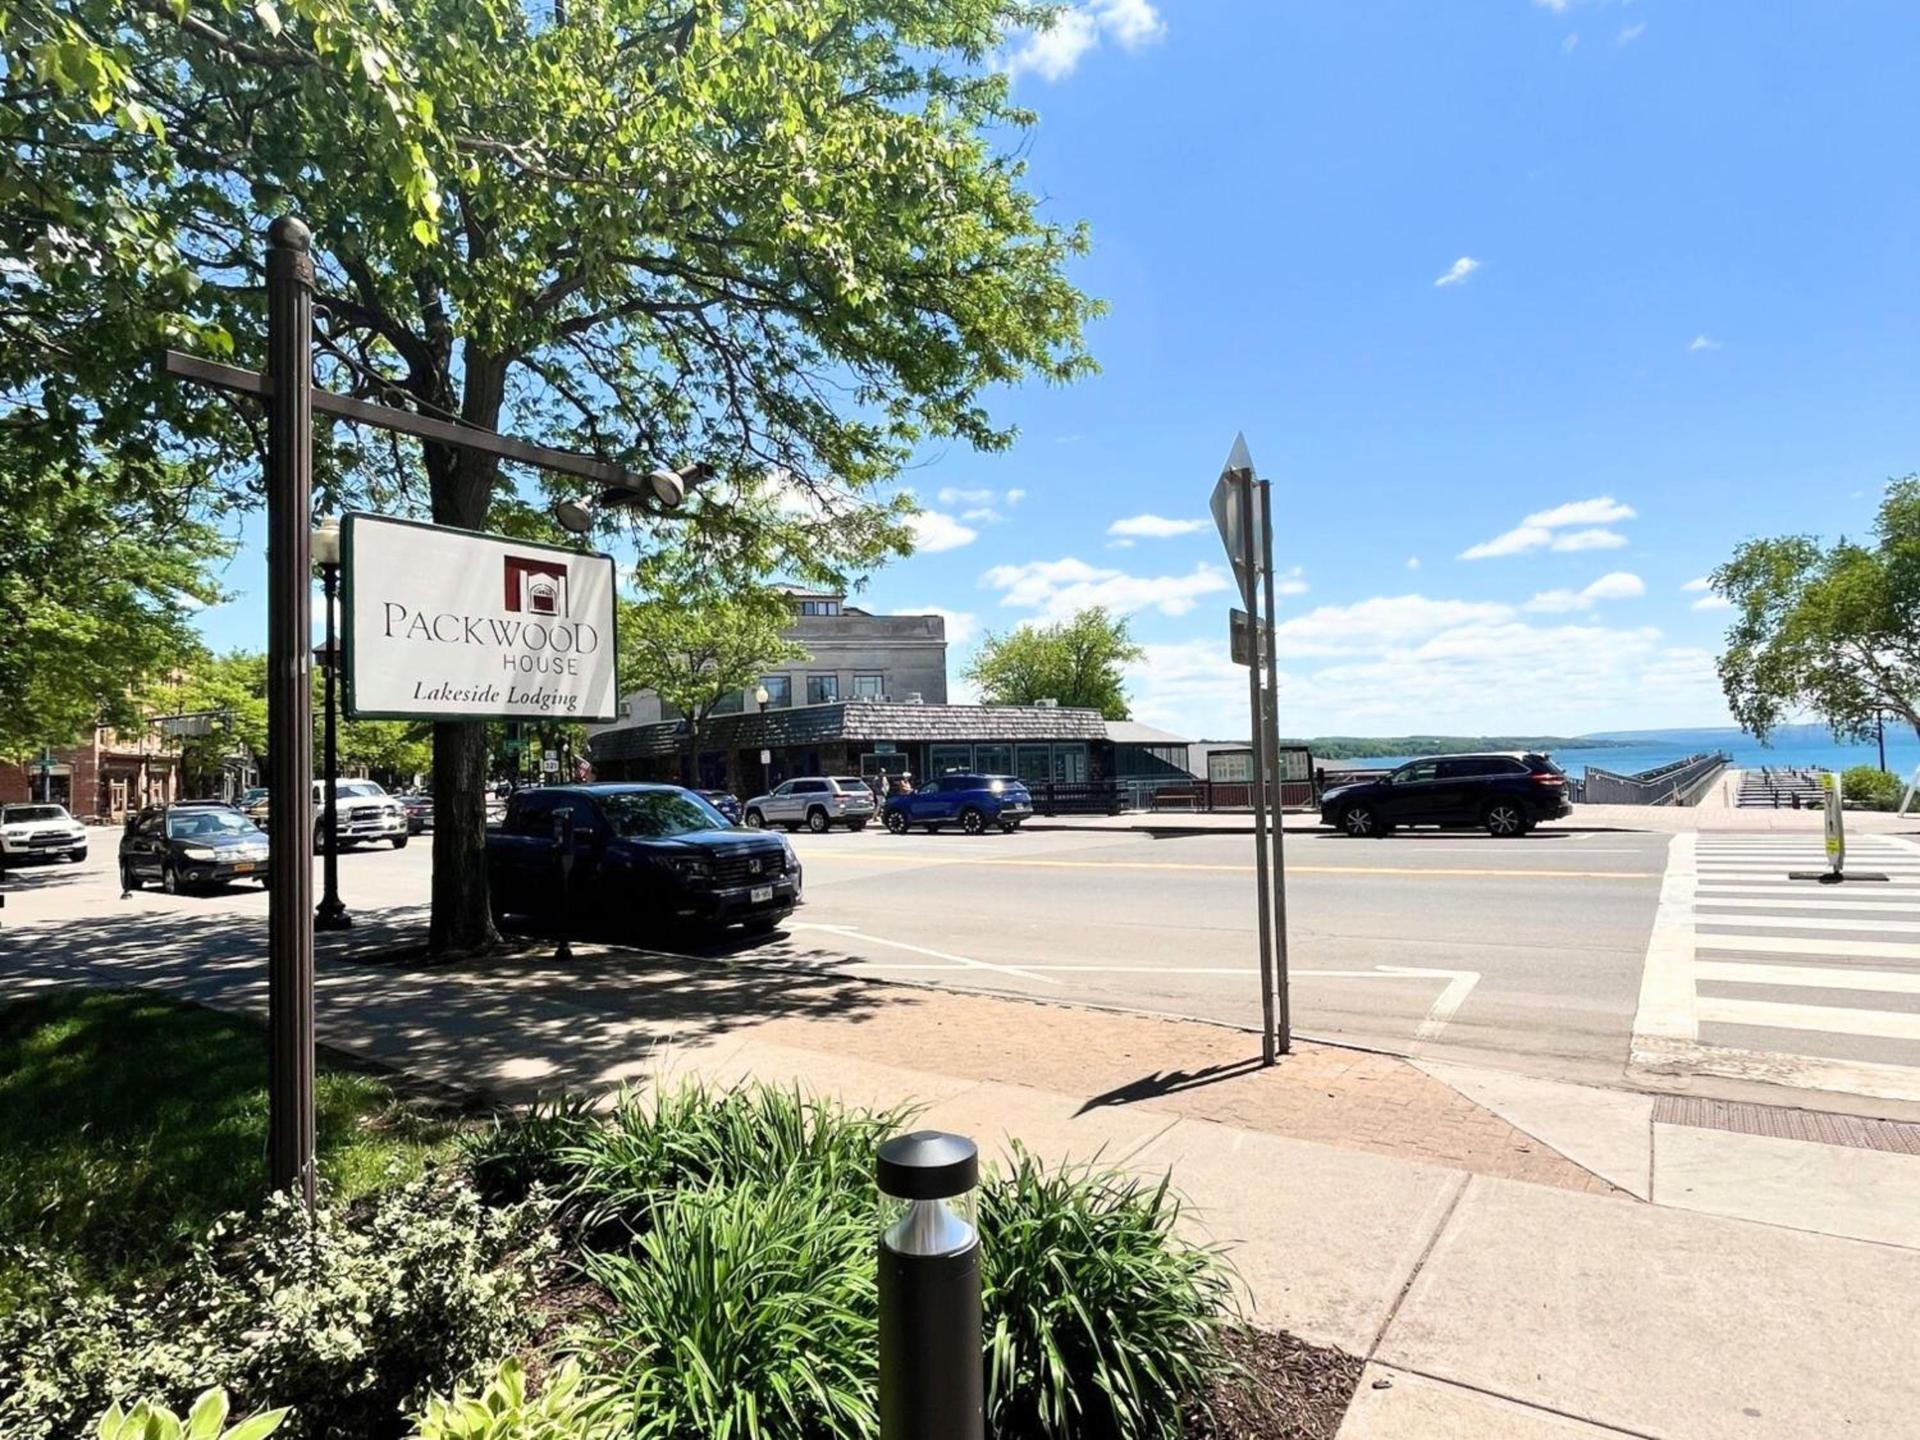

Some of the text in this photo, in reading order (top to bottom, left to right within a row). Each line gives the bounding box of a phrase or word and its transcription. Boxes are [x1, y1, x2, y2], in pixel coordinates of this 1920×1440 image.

[384, 602, 598, 654] PACKWOOD
[503, 654, 579, 676] HOUSE
[413, 681, 578, 711] Lakeside Lodging
